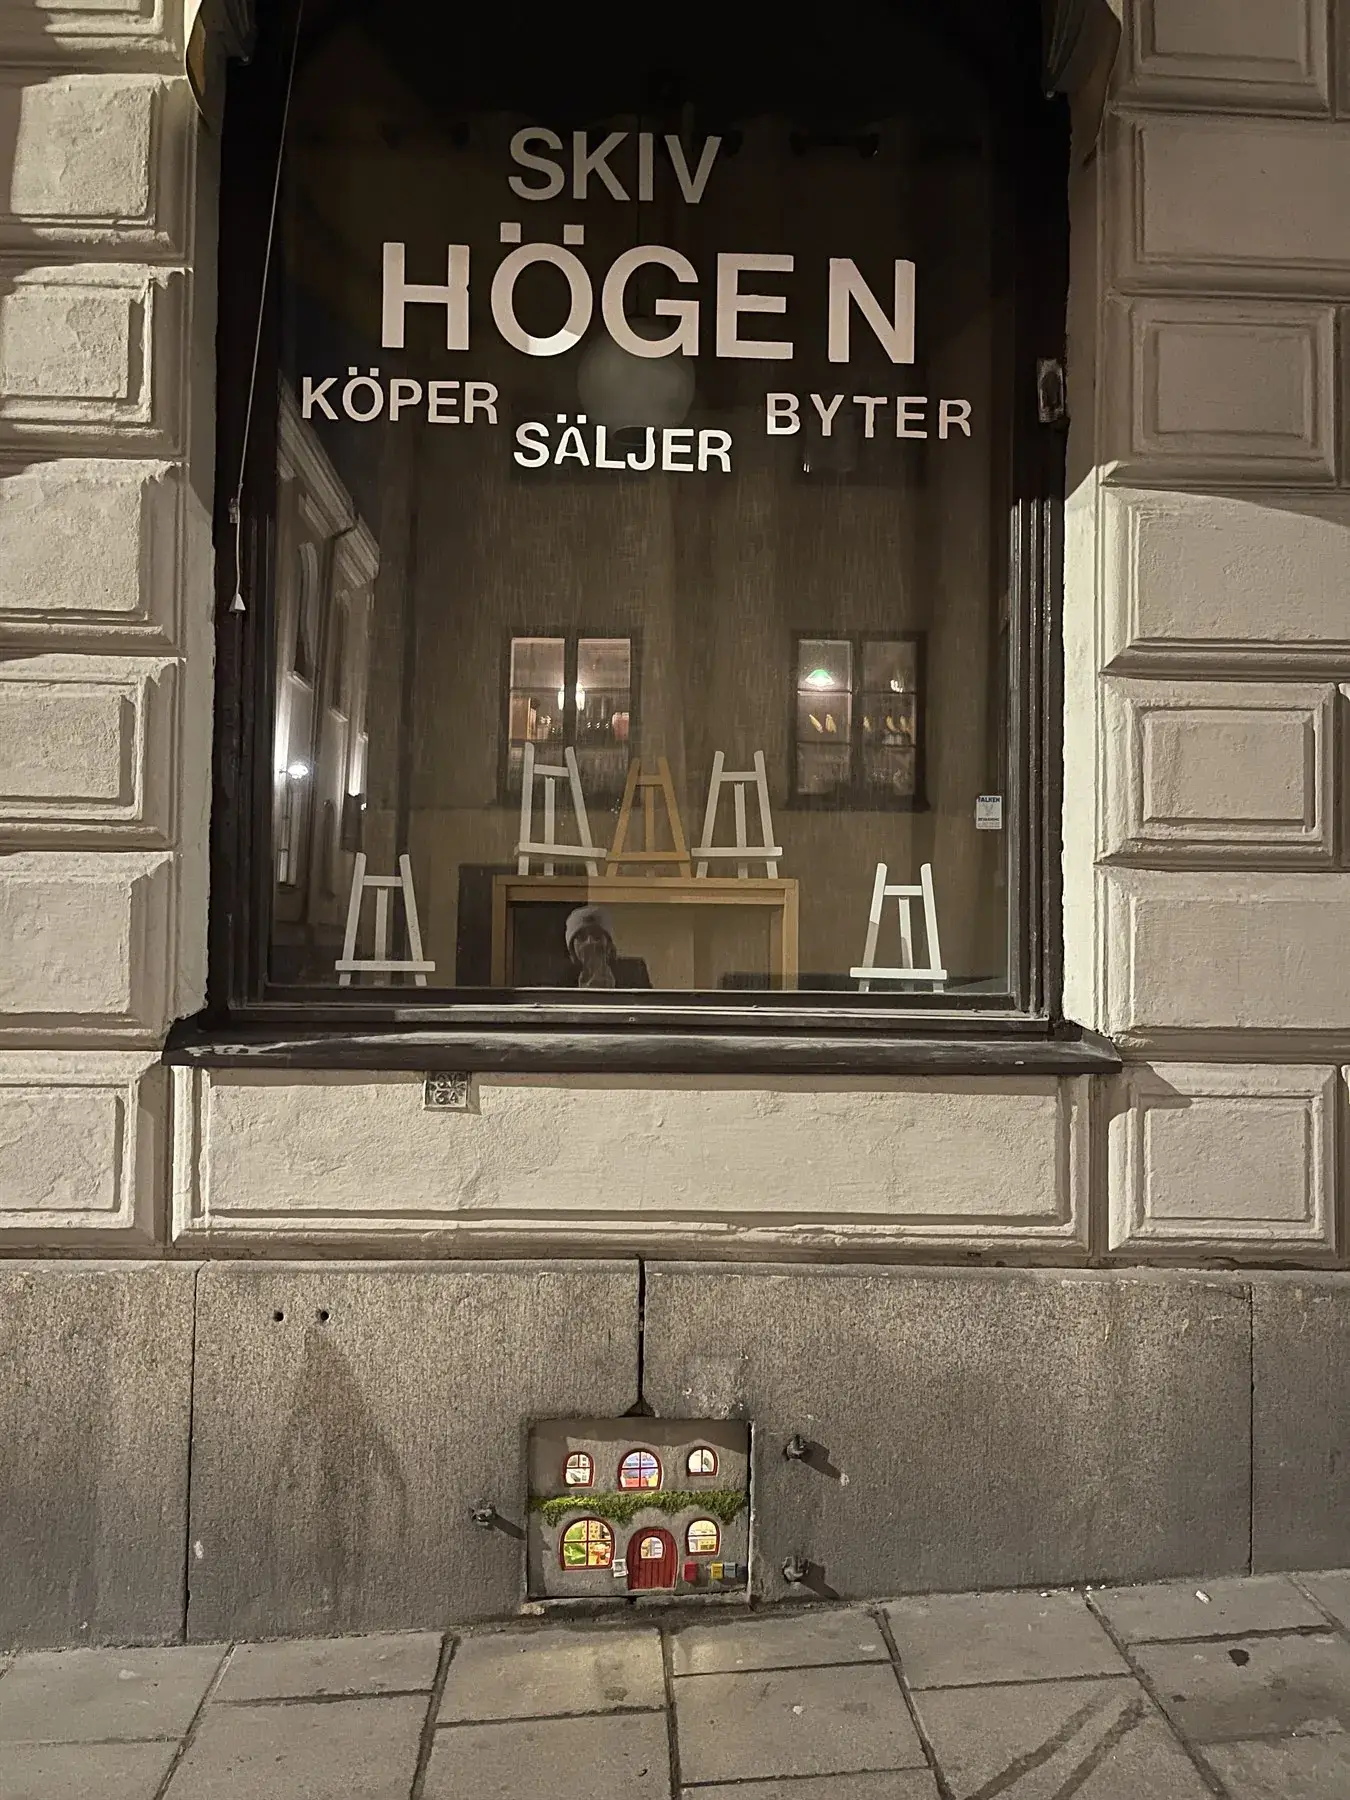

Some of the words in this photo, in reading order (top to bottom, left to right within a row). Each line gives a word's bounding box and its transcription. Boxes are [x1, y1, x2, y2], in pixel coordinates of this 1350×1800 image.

[508, 127, 722, 204] SKIV
[381, 222, 916, 364] HÖGEN
[301, 366, 499, 425] KÖPER
[766, 392, 973, 440] BYTER
[512, 413, 733, 473] SÄLJER
